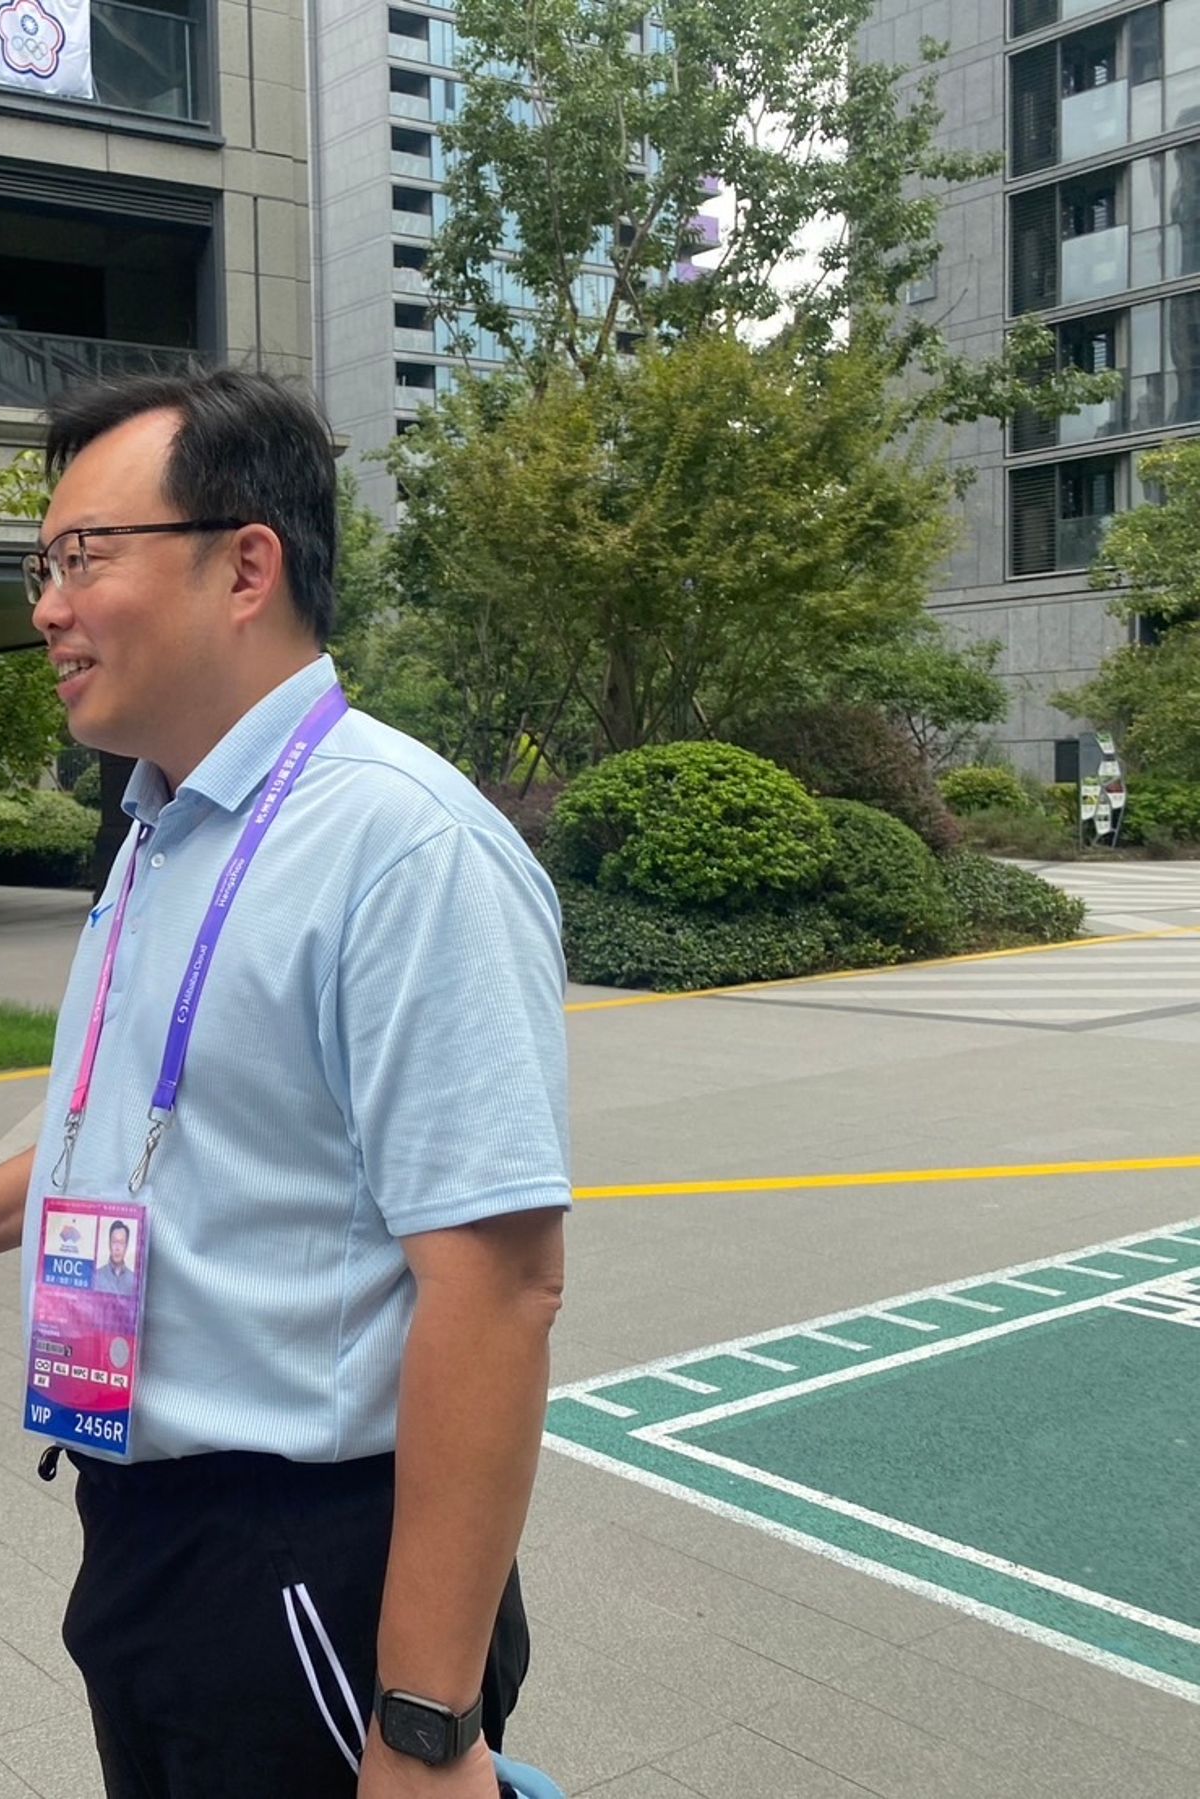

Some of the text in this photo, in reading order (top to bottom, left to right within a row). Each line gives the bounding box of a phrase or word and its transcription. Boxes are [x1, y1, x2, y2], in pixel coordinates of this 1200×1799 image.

[53, 1258, 83, 1276] NOC
[31, 1404, 124, 1442] VIP 2456R
